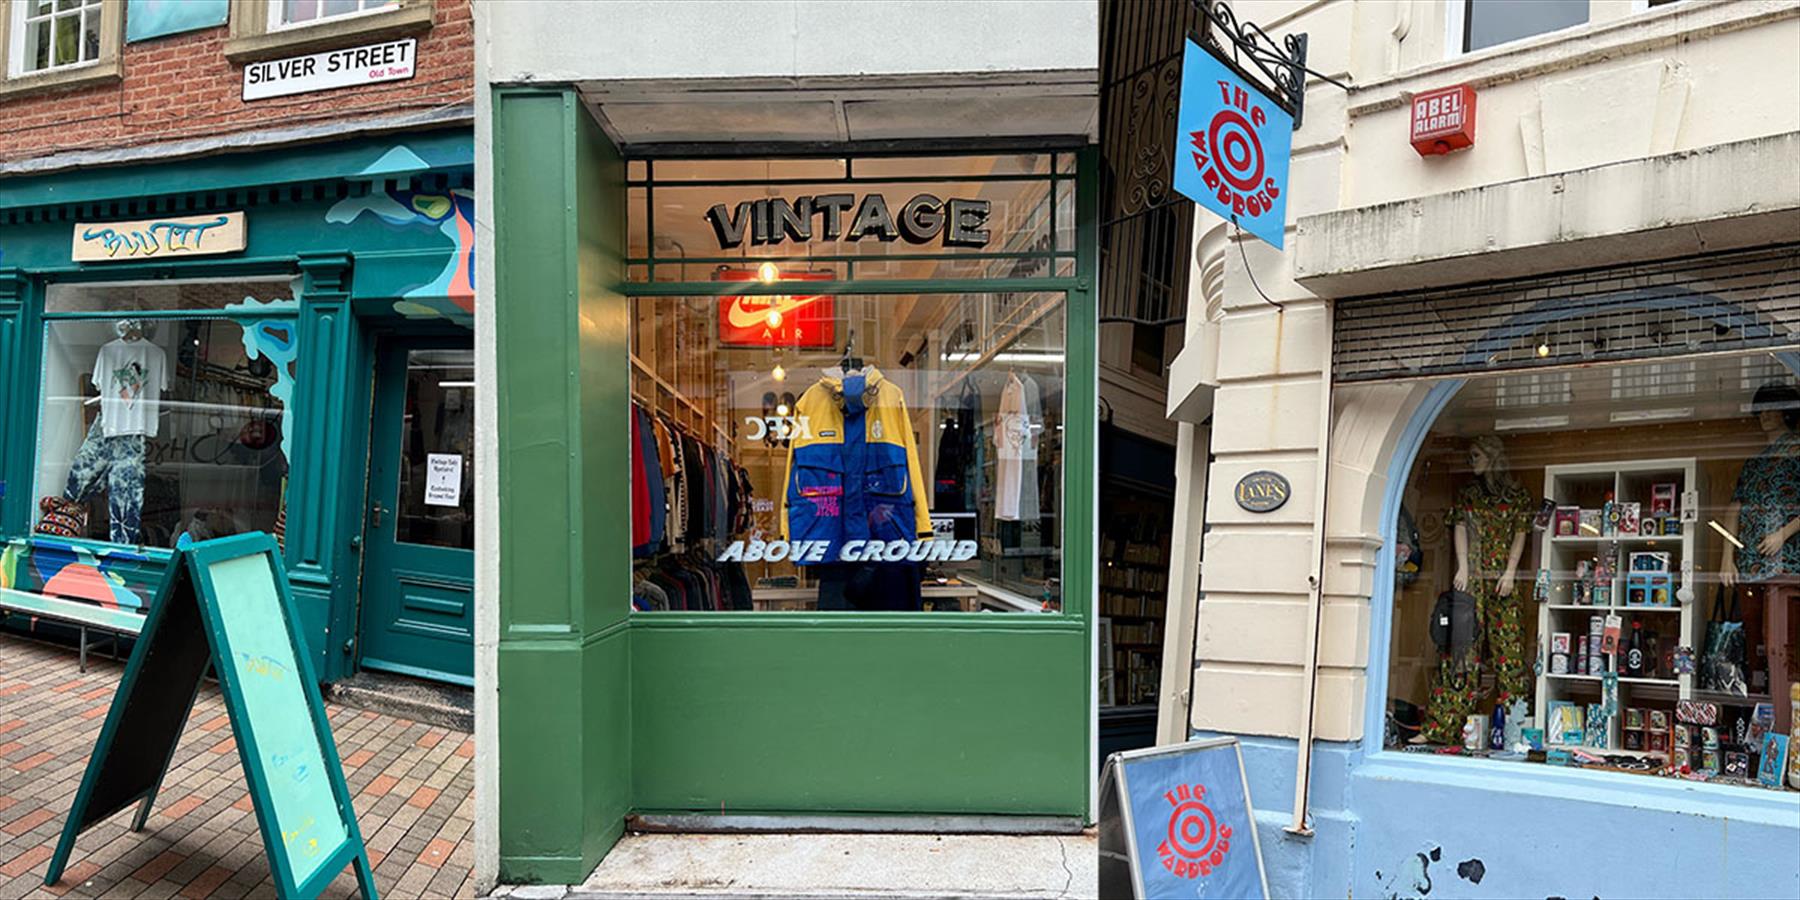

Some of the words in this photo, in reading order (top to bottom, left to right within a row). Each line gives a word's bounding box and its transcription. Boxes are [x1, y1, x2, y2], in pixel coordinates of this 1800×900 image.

[249, 57, 316, 84] SILVER
[327, 42, 410, 72] STREET
[368, 69, 384, 79] Old
[388, 66, 409, 76] Town
[1416, 93, 1460, 119] ABEL
[1415, 112, 1460, 134] ALARM
[704, 193, 991, 250] VINTAGE
[762, 328, 802, 340] AIR
[716, 540, 832, 562] ABOVE
[839, 539, 978, 562] GROUND
